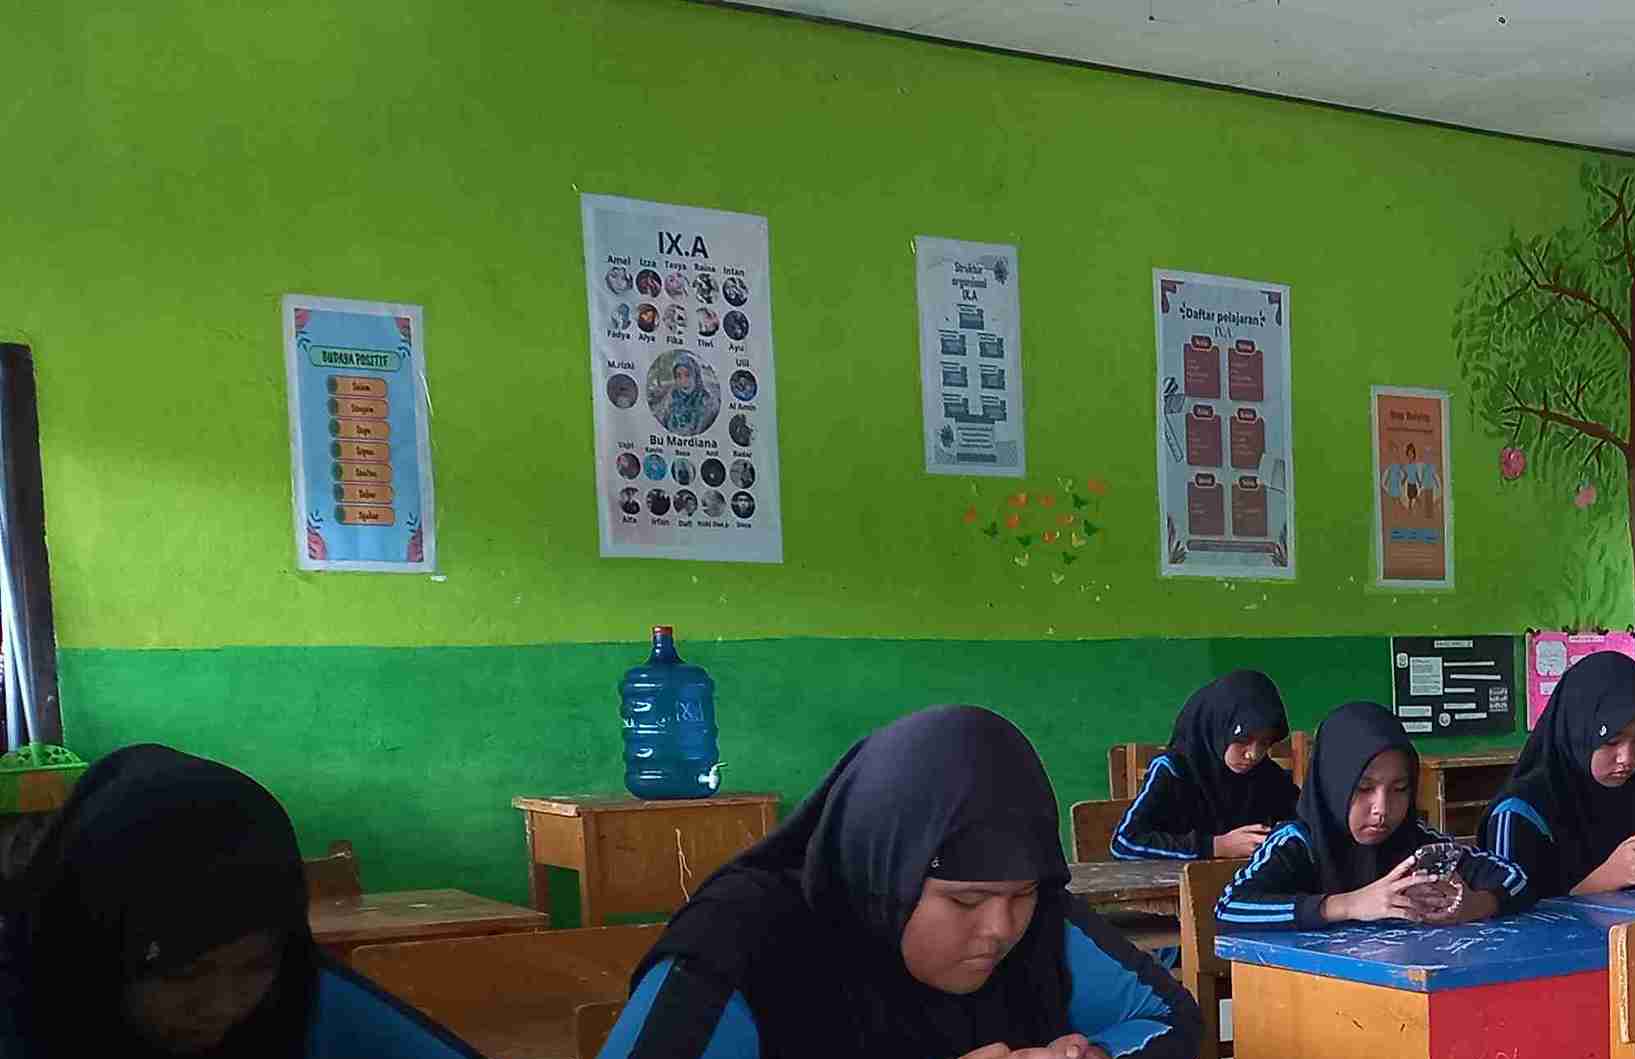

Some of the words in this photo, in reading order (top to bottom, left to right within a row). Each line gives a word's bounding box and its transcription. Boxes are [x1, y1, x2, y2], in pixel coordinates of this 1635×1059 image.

[658, 231, 709, 258] IX.A
[1186, 307, 1215, 320] Daftar
[650, 435, 664, 446] Bu
[666, 436, 718, 449] Mardiana
